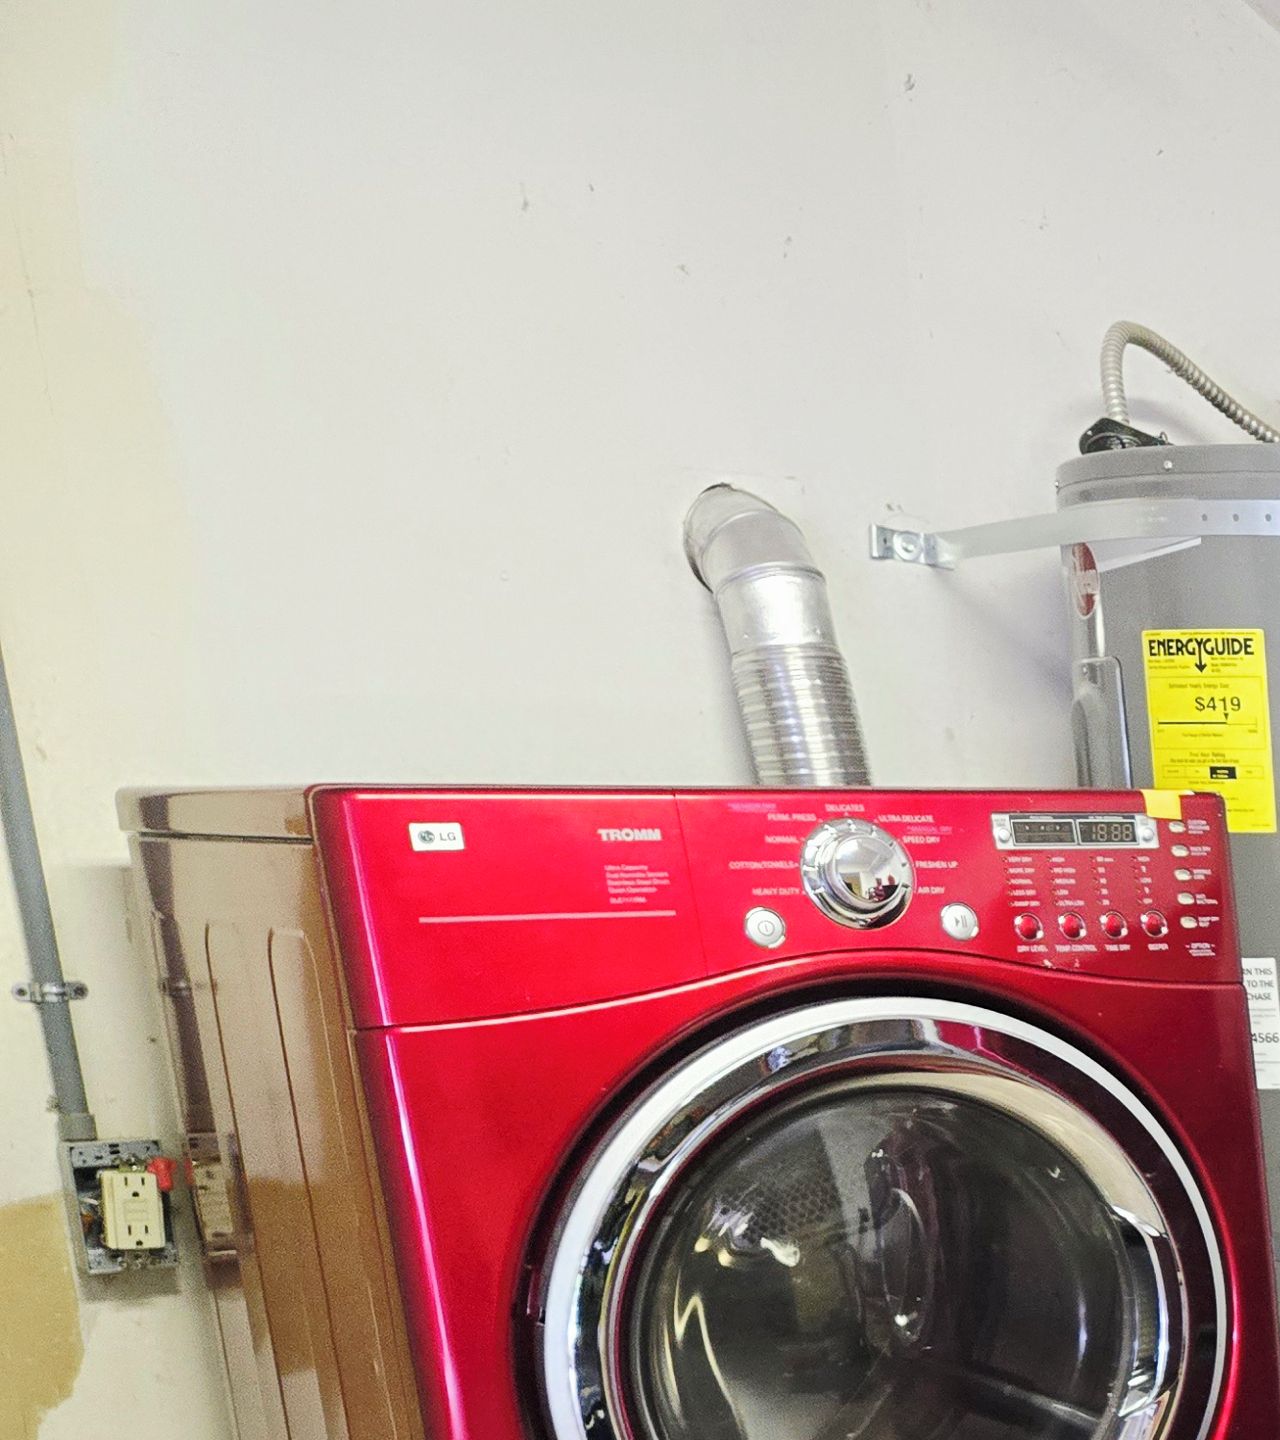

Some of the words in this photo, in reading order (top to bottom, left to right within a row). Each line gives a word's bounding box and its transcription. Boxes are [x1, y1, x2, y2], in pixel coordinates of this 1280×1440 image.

[1148, 638, 1255, 657] ENERGYGUIDE
[1194, 696, 1241, 712] $419
[439, 832, 457, 842] LG
[597, 828, 662, 842] TROMM
[903, 835, 925, 844] SPEED
[926, 835, 940, 844] DRY
[918, 886, 930, 894] AIR
[1255, 968, 1273, 976] THIS
[1248, 980, 1258, 988] TO
[1259, 980, 1274, 988] THE
